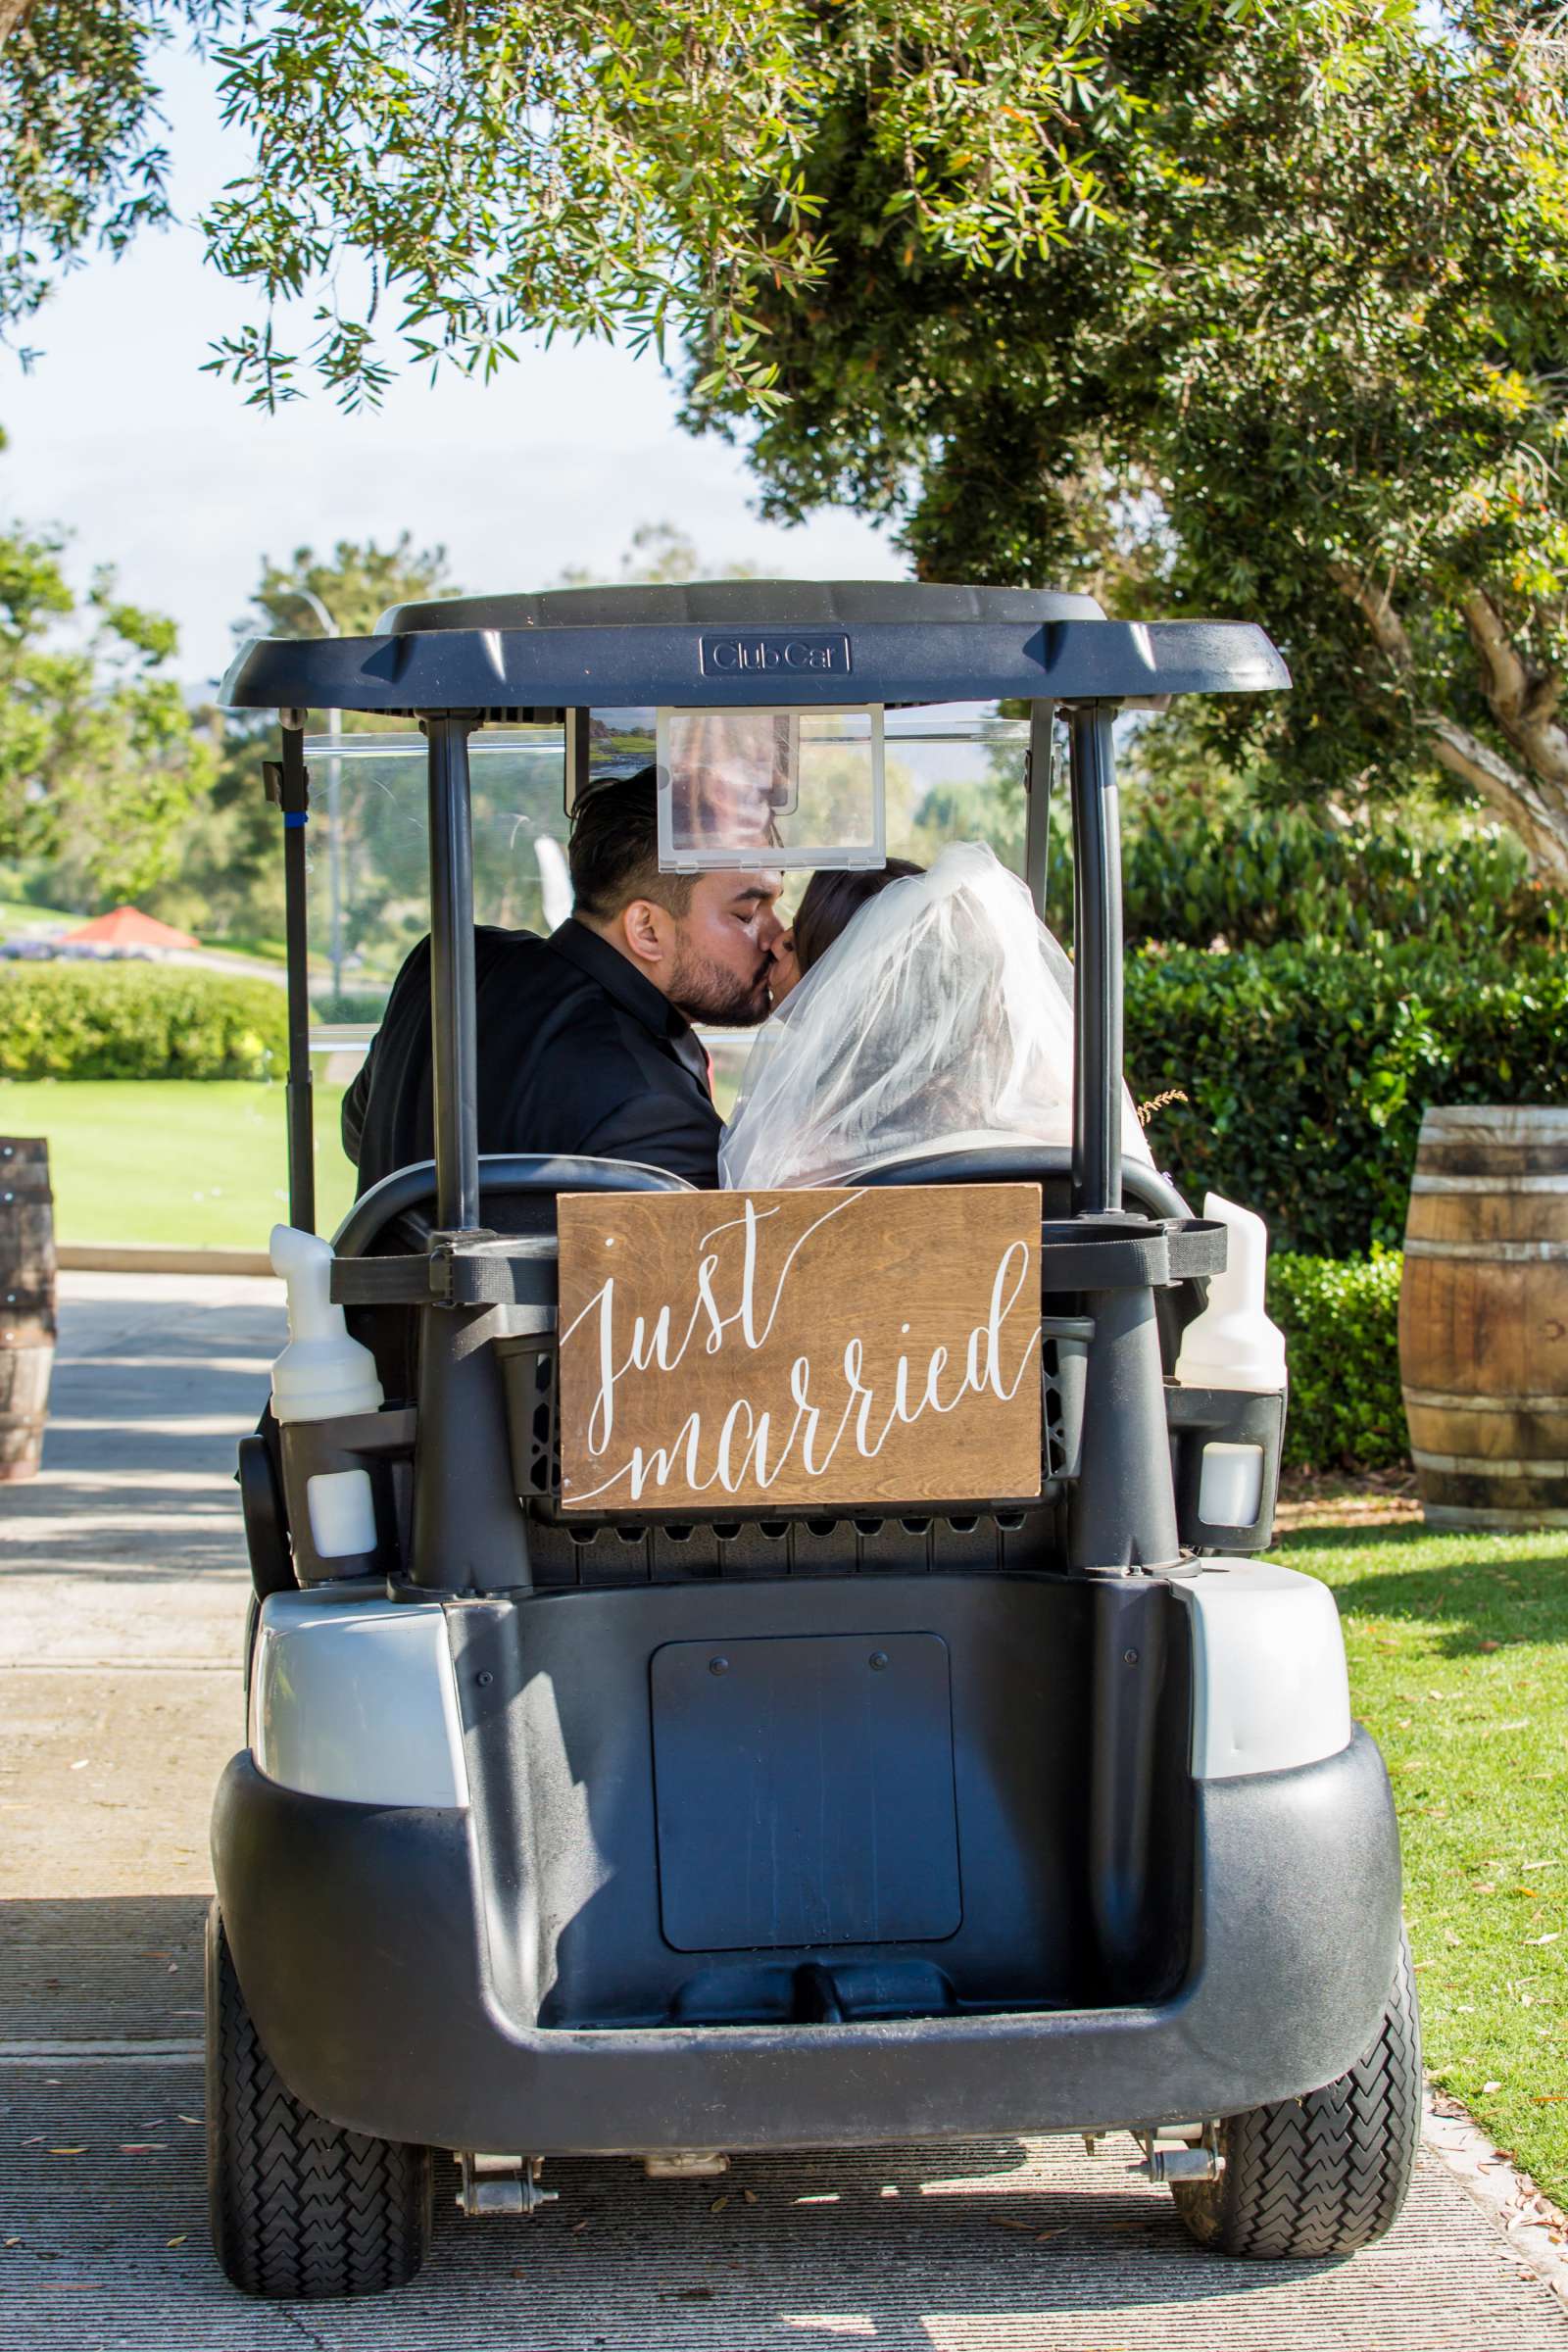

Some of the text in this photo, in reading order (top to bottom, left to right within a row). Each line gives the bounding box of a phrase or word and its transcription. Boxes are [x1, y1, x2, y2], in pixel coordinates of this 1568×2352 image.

[712, 641, 835, 669] Club Car
[560, 1189, 869, 1456] just
[562, 1241, 1042, 1501] married
